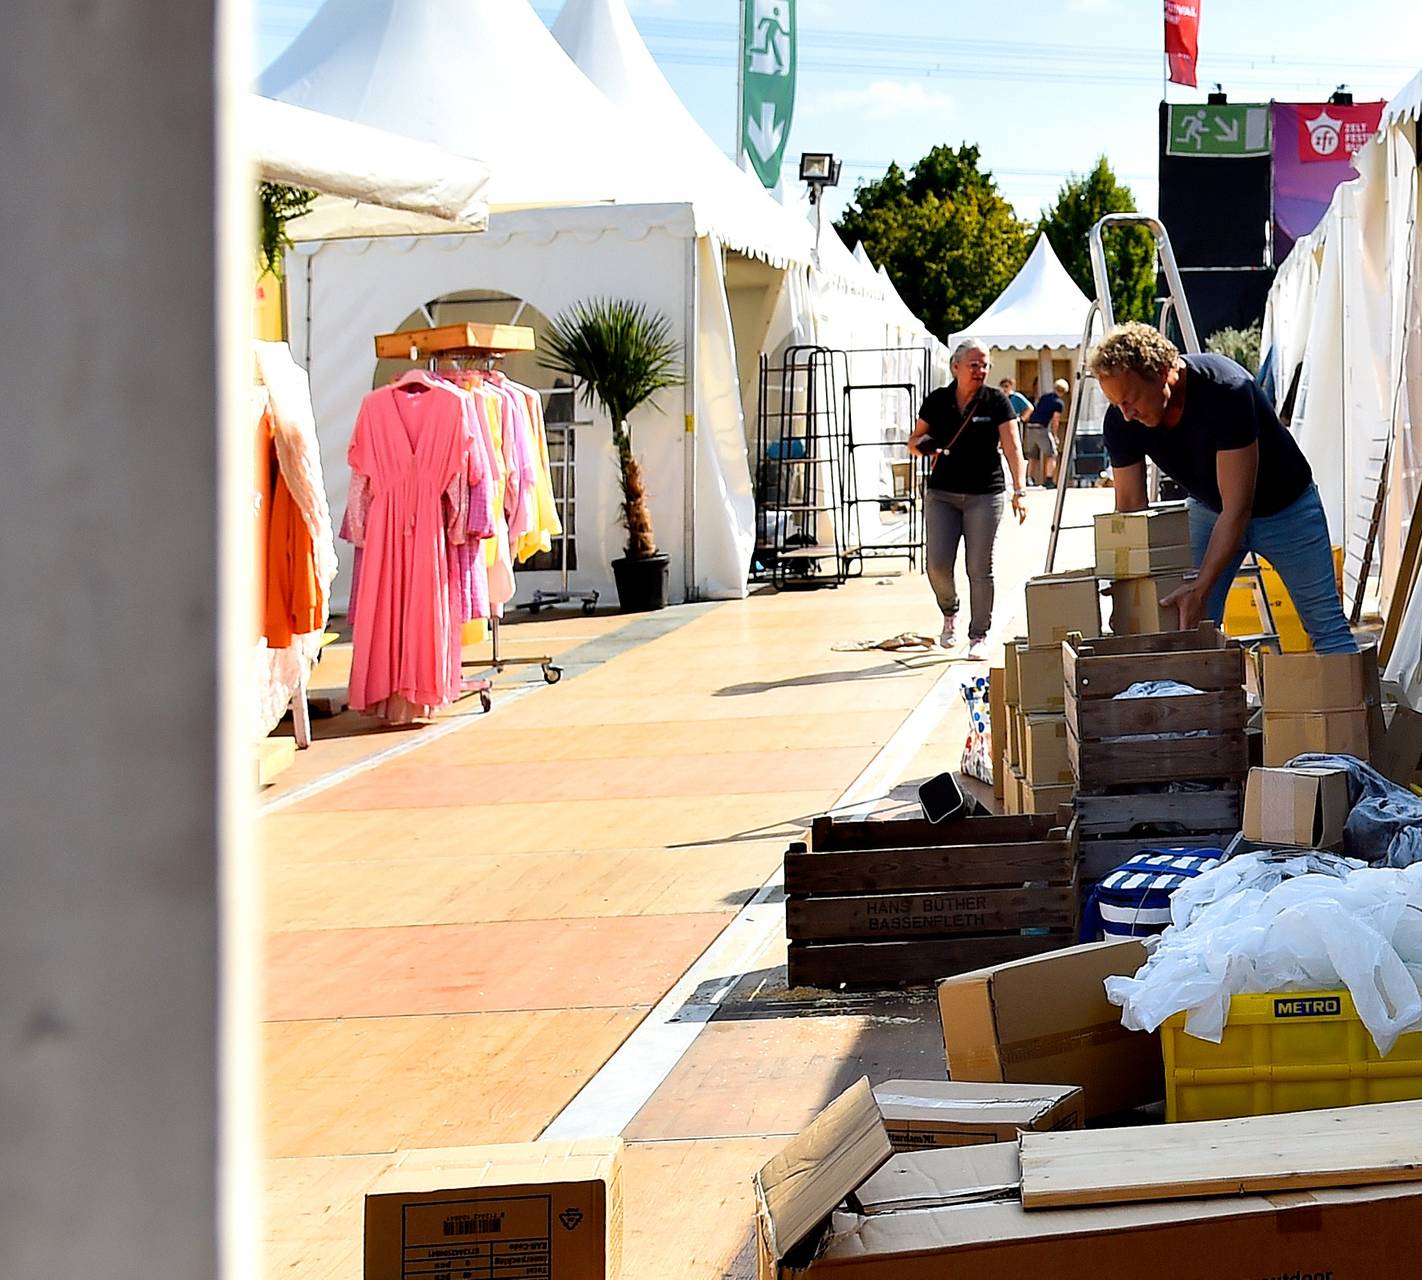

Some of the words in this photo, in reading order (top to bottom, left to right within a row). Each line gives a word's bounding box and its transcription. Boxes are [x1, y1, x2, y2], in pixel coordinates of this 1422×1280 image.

[866, 899, 912, 915] HANS
[868, 913, 985, 931] BASSENFLETH
[1277, 999, 1338, 1015] METRO
